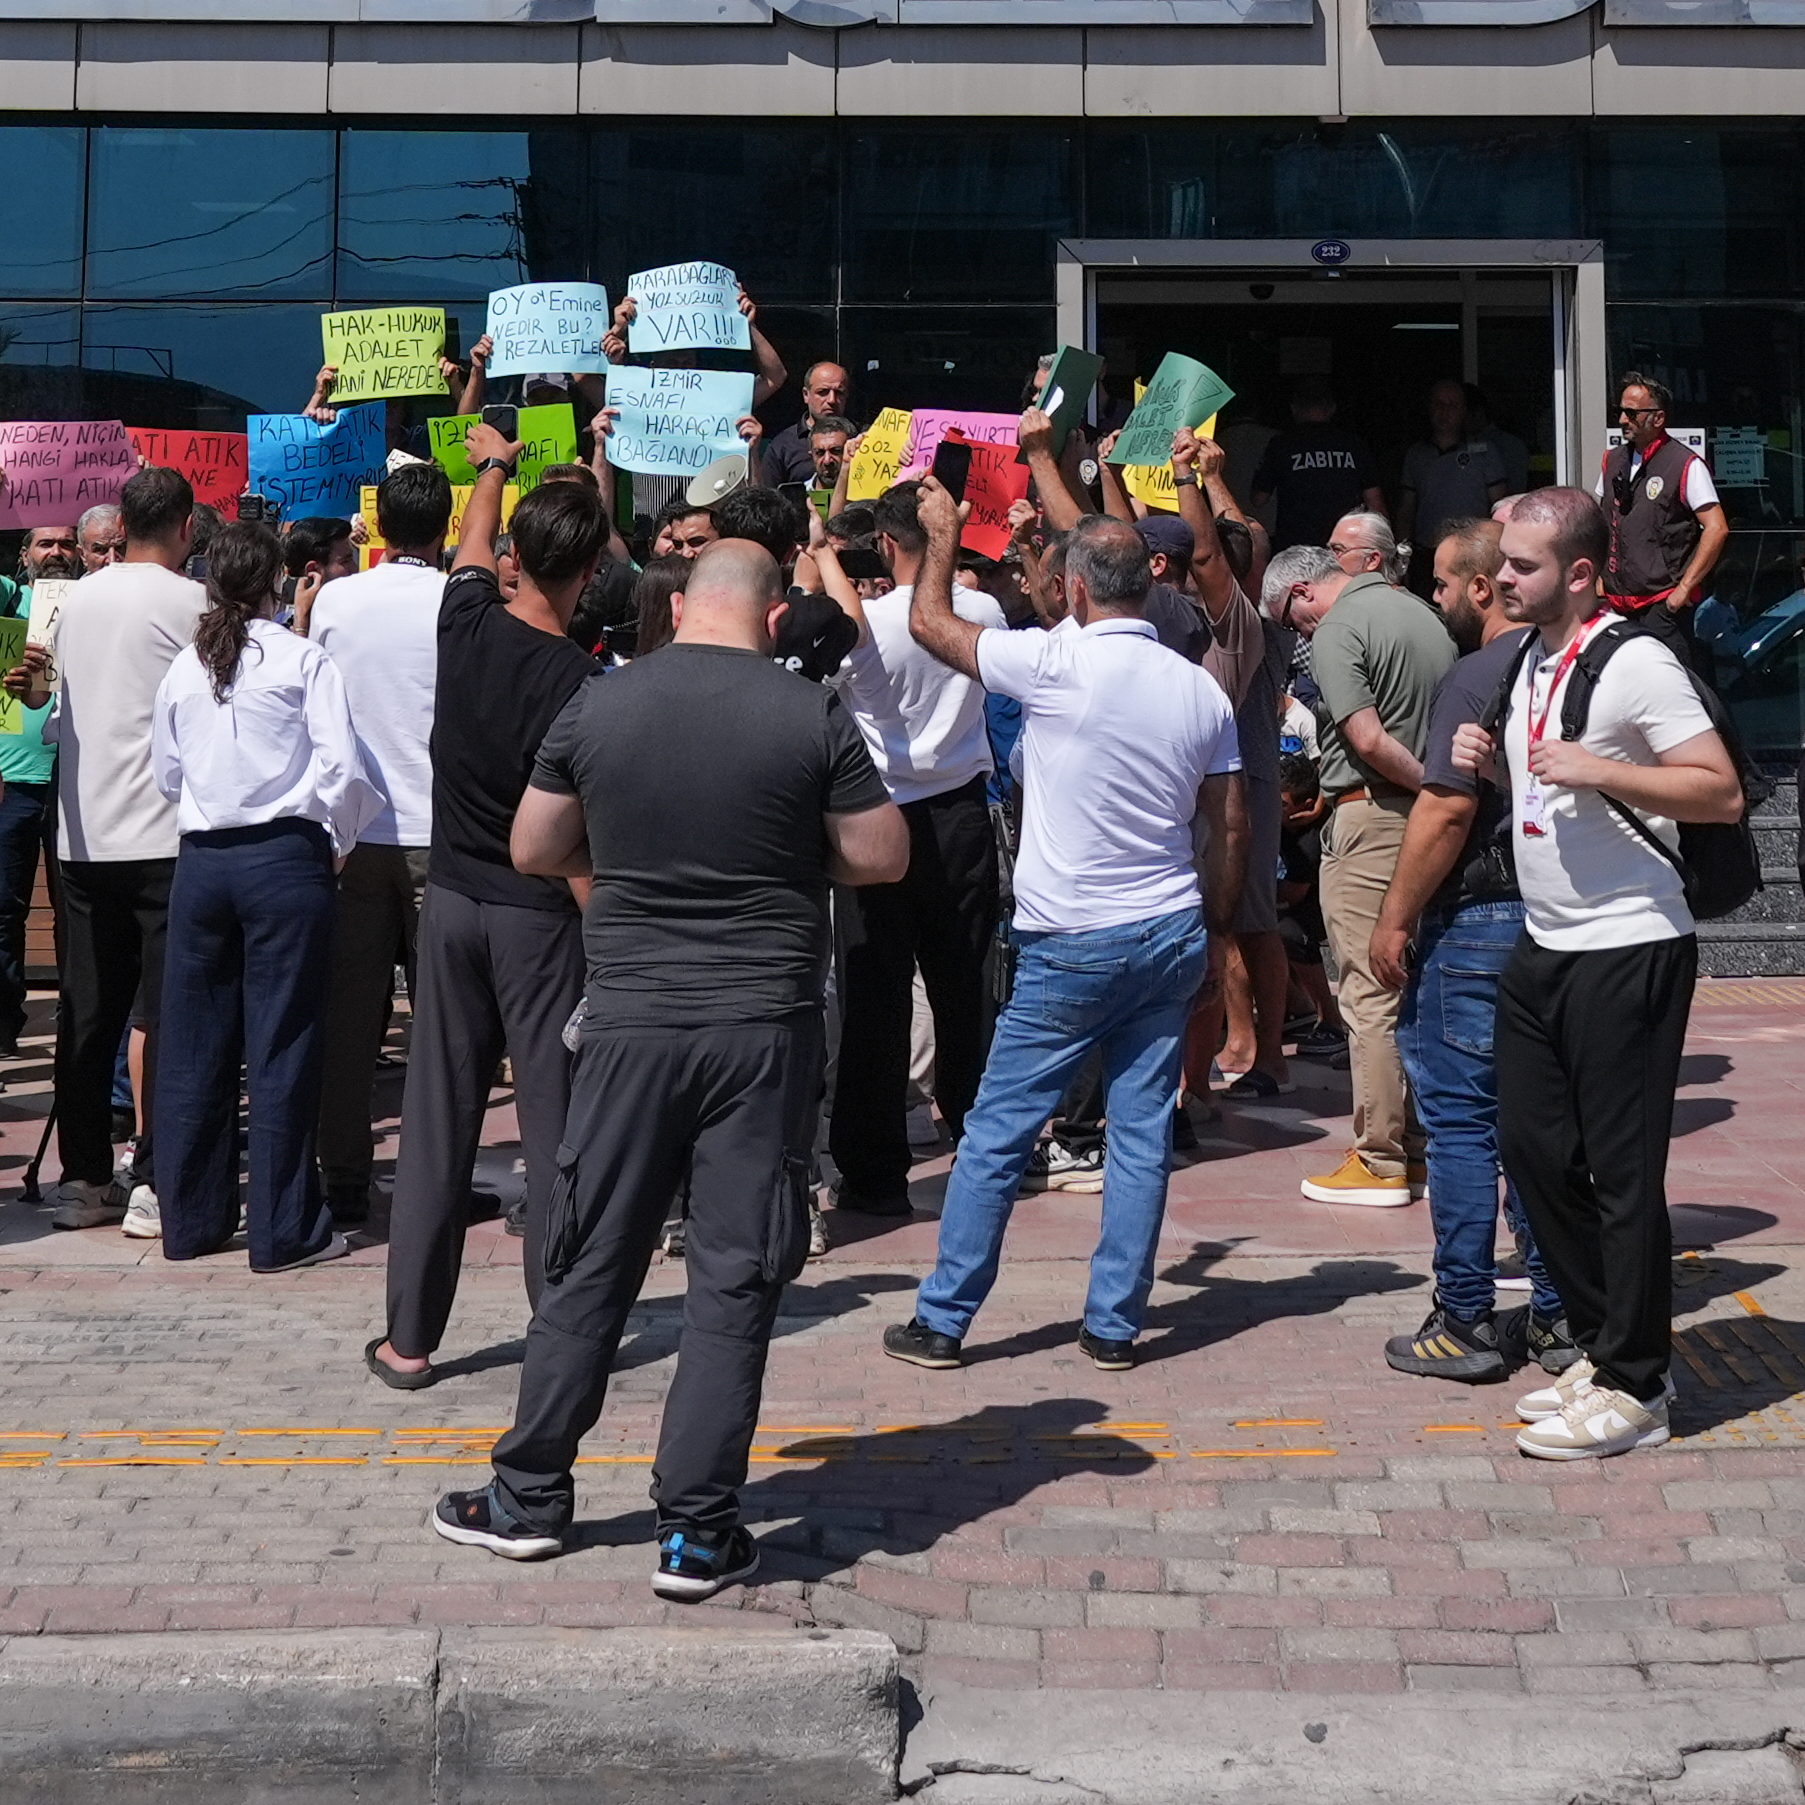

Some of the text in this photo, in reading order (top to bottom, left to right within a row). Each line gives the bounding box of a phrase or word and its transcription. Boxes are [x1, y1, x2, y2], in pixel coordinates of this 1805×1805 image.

[549, 290, 603, 312] Emine
[343, 339, 424, 365] ADALET
[609, 388, 686, 410] ESNAFI
[336, 408, 381, 439] ATIK
[131, 433, 240, 468] ATI ATIK
[283, 438, 365, 472] BEDELİ
[1291, 450, 1356, 471] ZABITA
[9, 475, 121, 509] KATI ATIK
[398, 555, 427, 567] SONY
